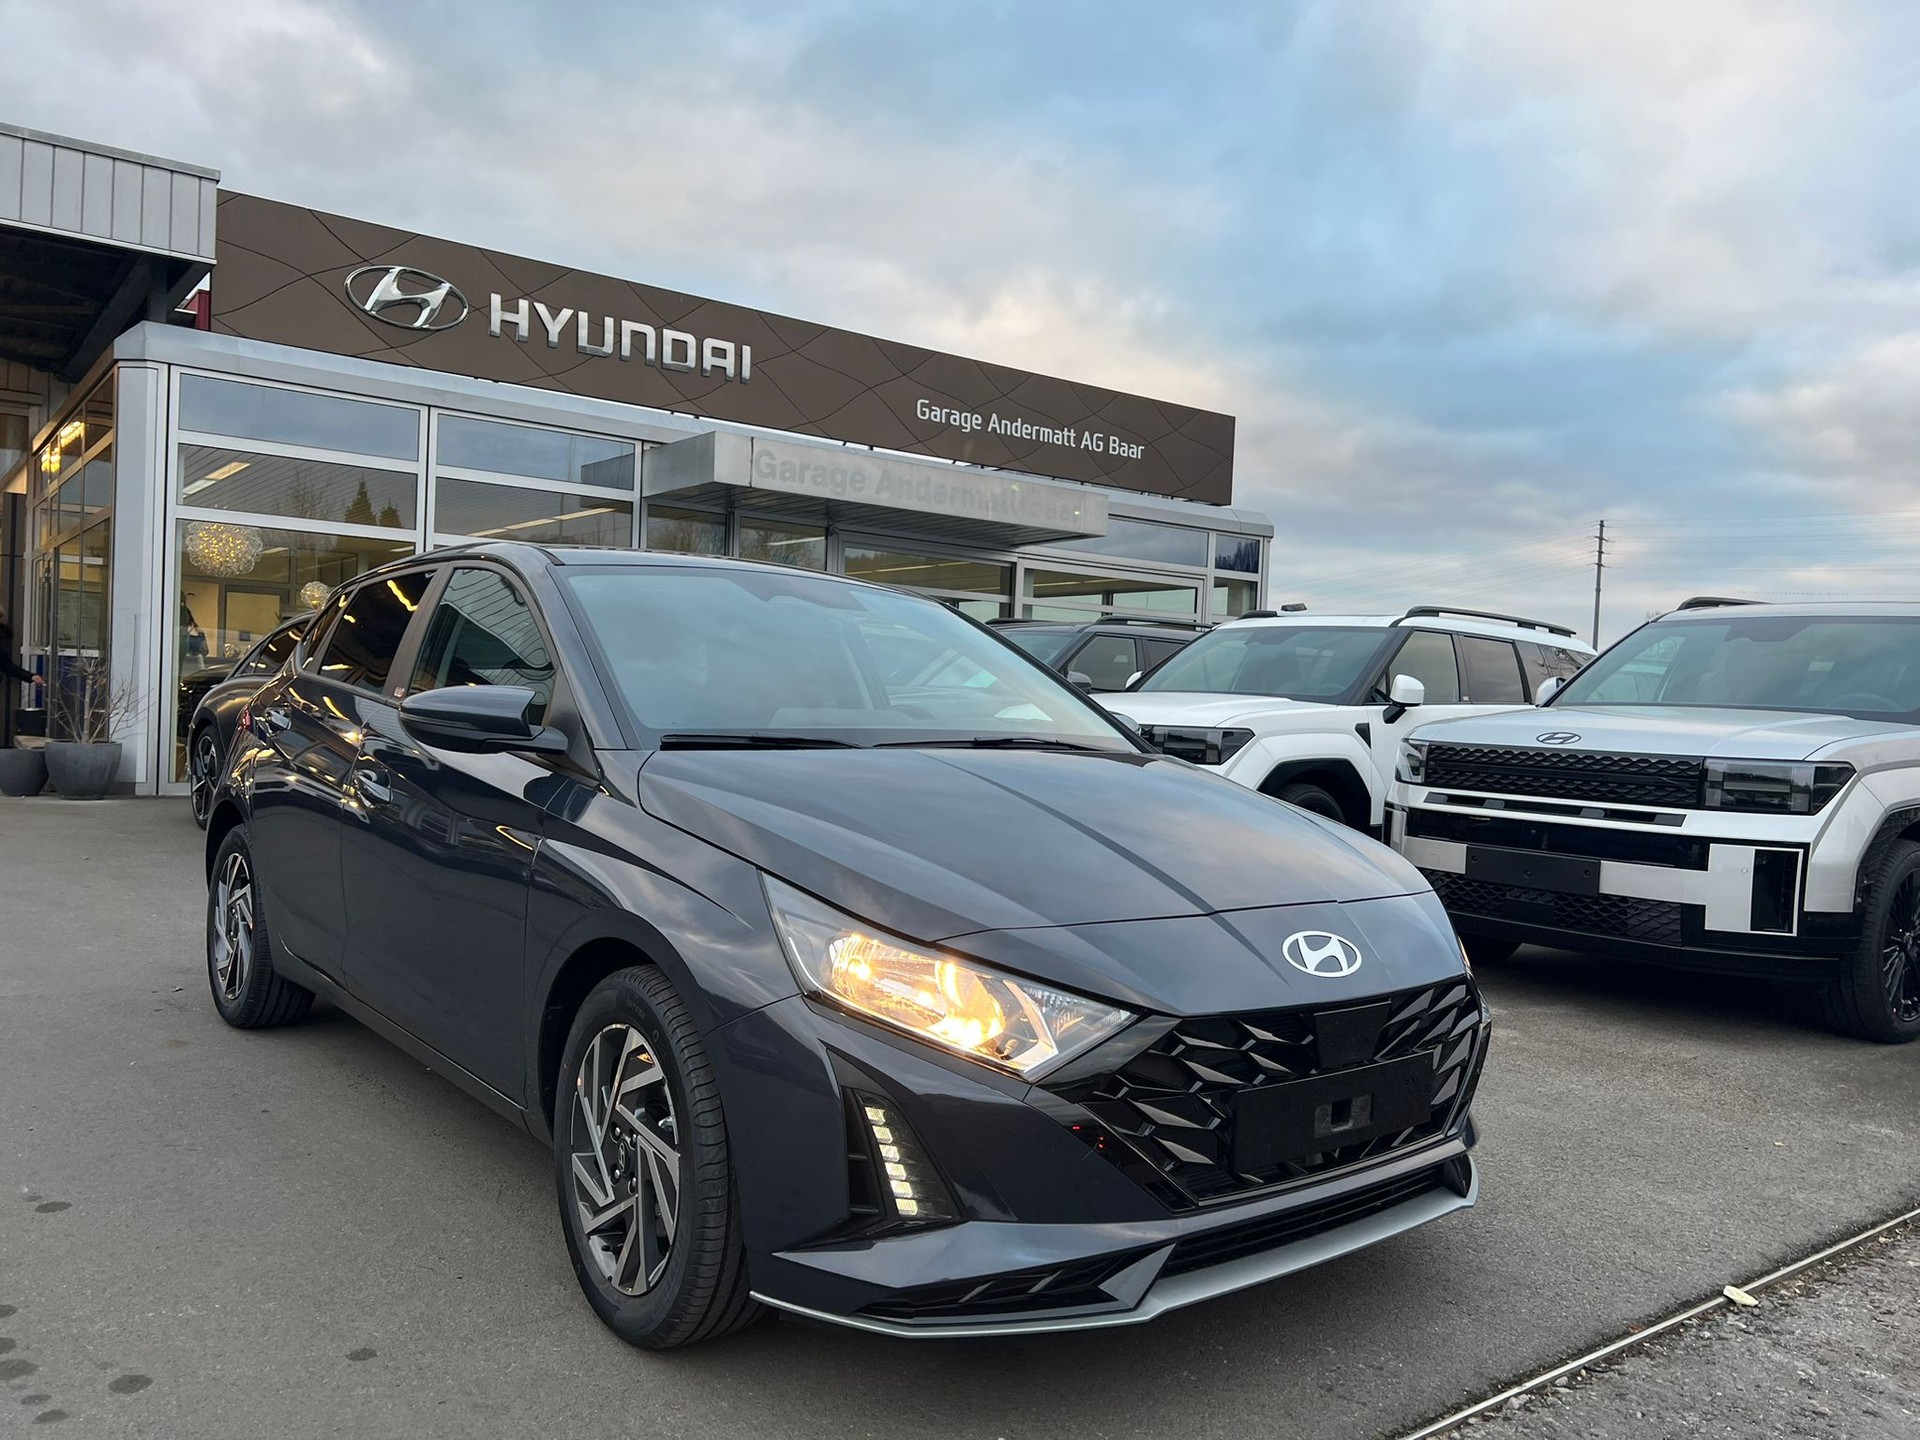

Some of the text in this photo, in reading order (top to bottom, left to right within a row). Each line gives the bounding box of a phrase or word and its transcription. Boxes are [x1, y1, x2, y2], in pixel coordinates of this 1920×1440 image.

[489, 292, 752, 384] HYUNDAI
[916, 398, 1145, 459] Garage Andermatt AG Baar
[753, 448, 867, 496] Garage
